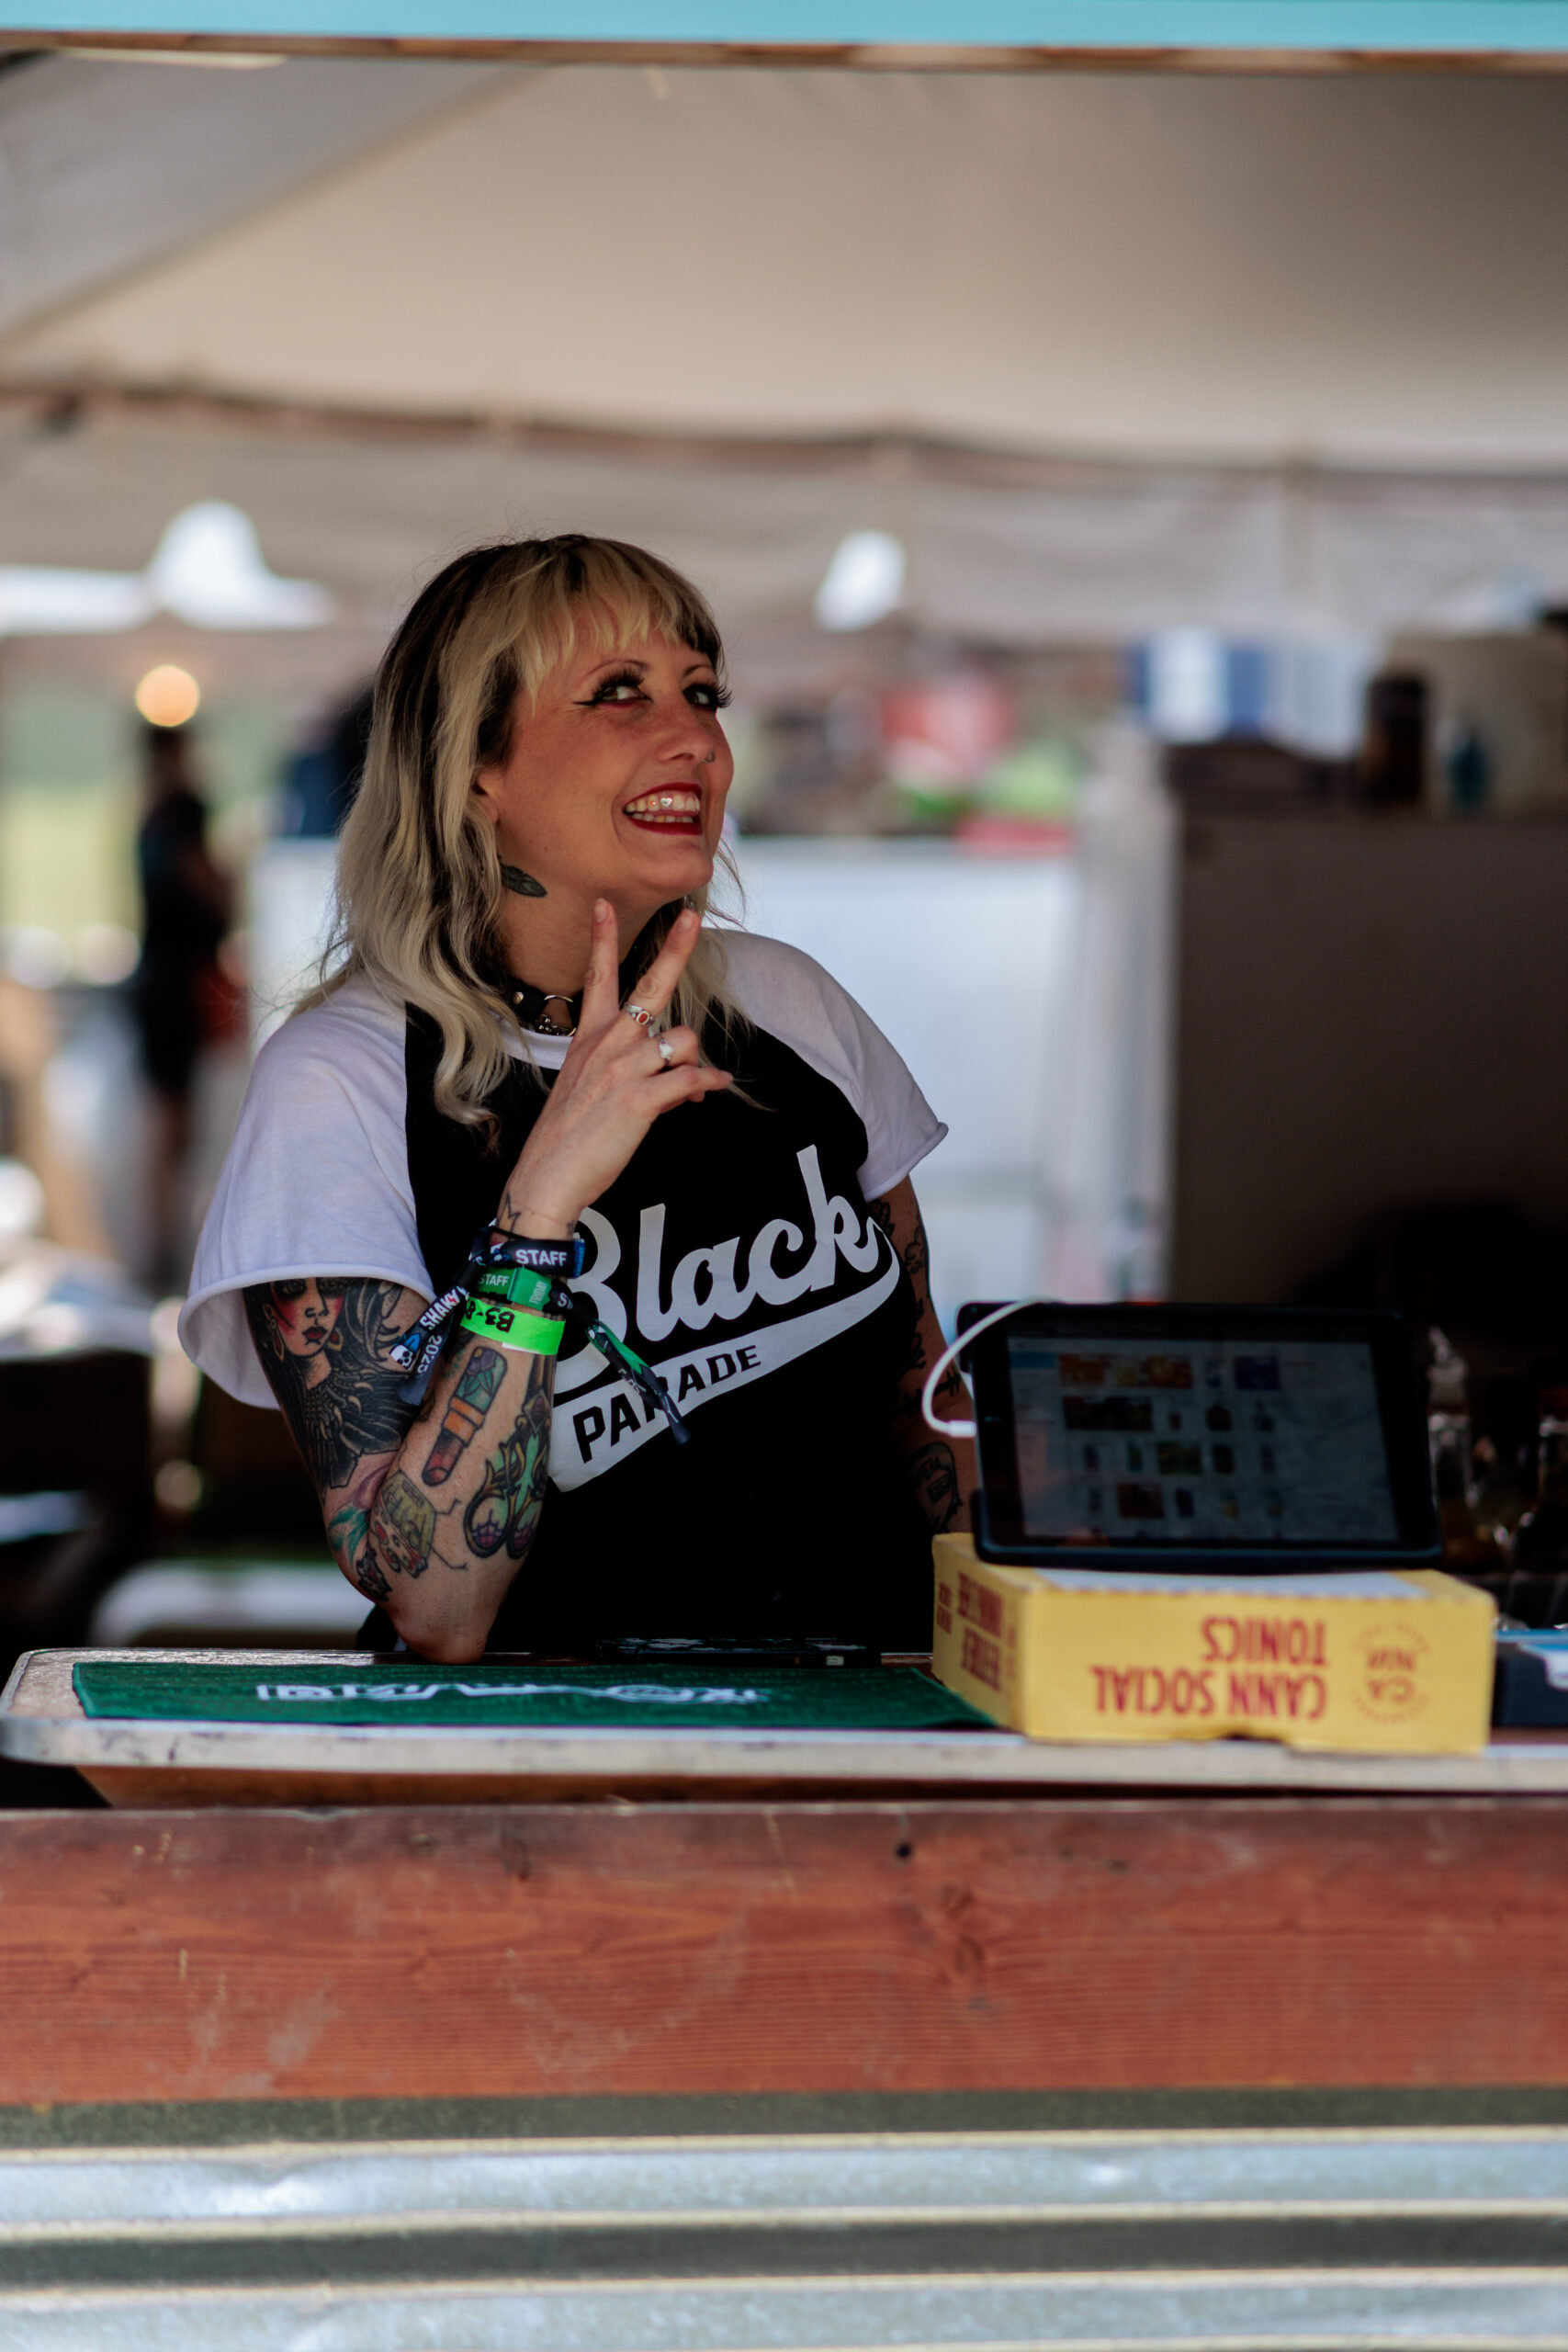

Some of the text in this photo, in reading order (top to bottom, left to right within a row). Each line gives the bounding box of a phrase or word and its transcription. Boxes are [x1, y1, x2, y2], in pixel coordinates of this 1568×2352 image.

[515, 1249, 568, 1267] STAFF
[419, 1288, 461, 1331] SHAKY
[1201, 1616, 1327, 1667] TONICS
[1090, 1666, 1216, 1716] SOCIAL
[1227, 1670, 1327, 1721] CANN
